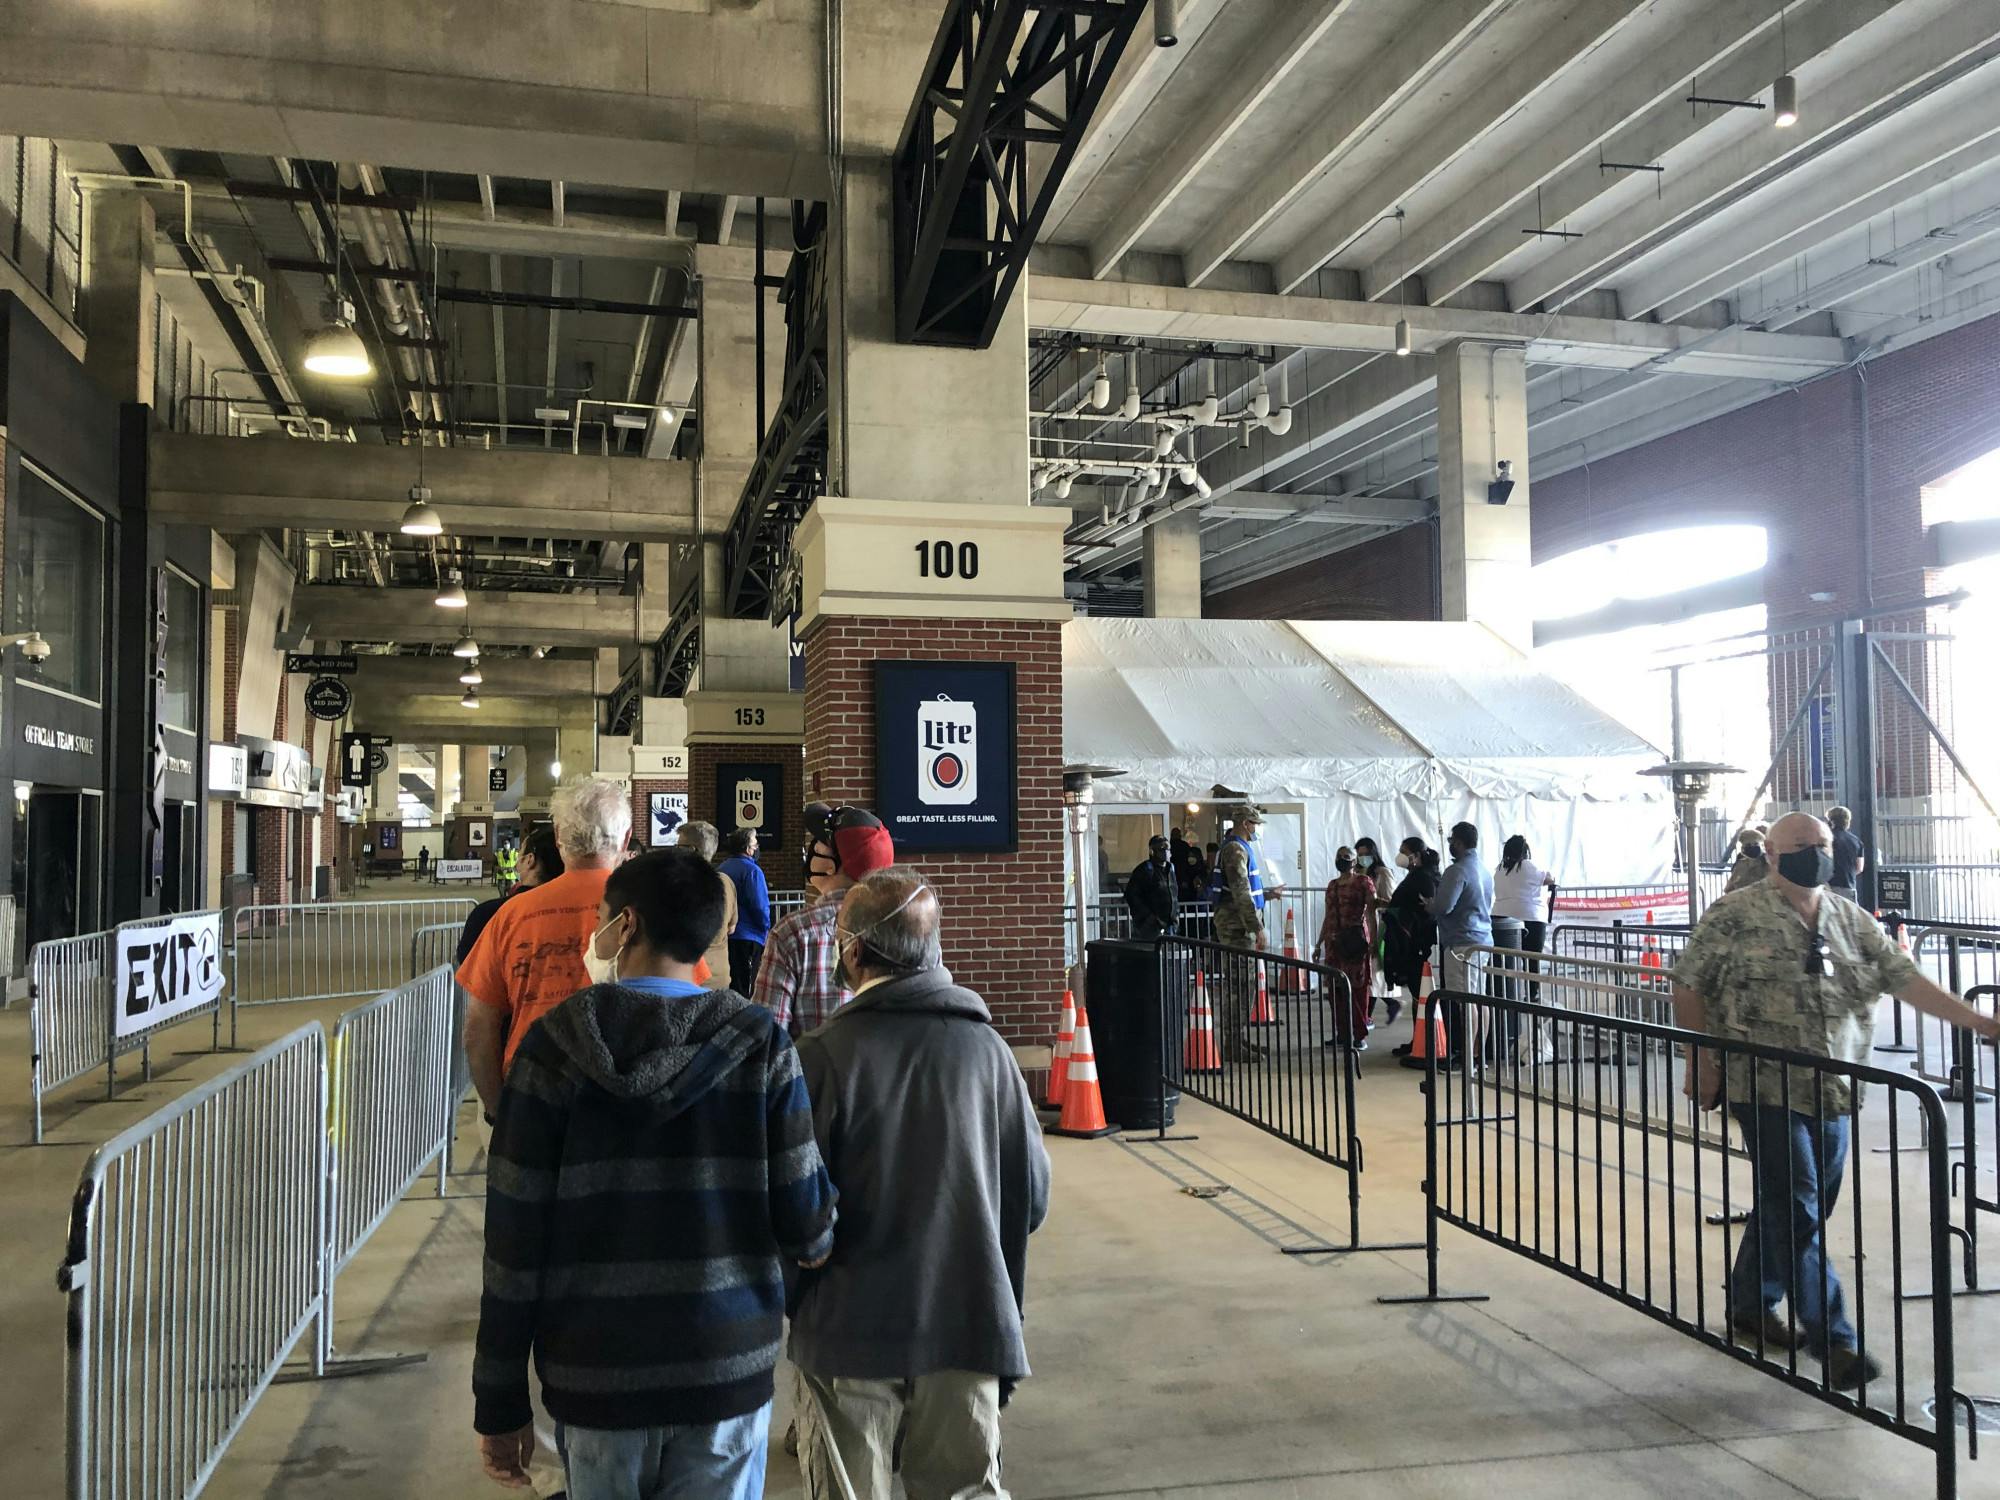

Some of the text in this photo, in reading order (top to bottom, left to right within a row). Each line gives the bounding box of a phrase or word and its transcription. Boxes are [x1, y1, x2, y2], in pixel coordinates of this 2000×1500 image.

[915, 540, 979, 579] 100
[734, 708, 765, 726] 153
[25, 724, 94, 755] OFFICIAL TEAM STORE
[923, 720, 972, 751] Lite
[662, 757, 682, 768] 152
[660, 797, 683, 810] Lite
[739, 789, 762, 804] Lite
[446, 864, 473, 873] ESCALATOR
[1883, 881, 1905, 890] ENTER
[1885, 891, 1904, 900] HERE
[126, 932, 197, 1016] EXIT
